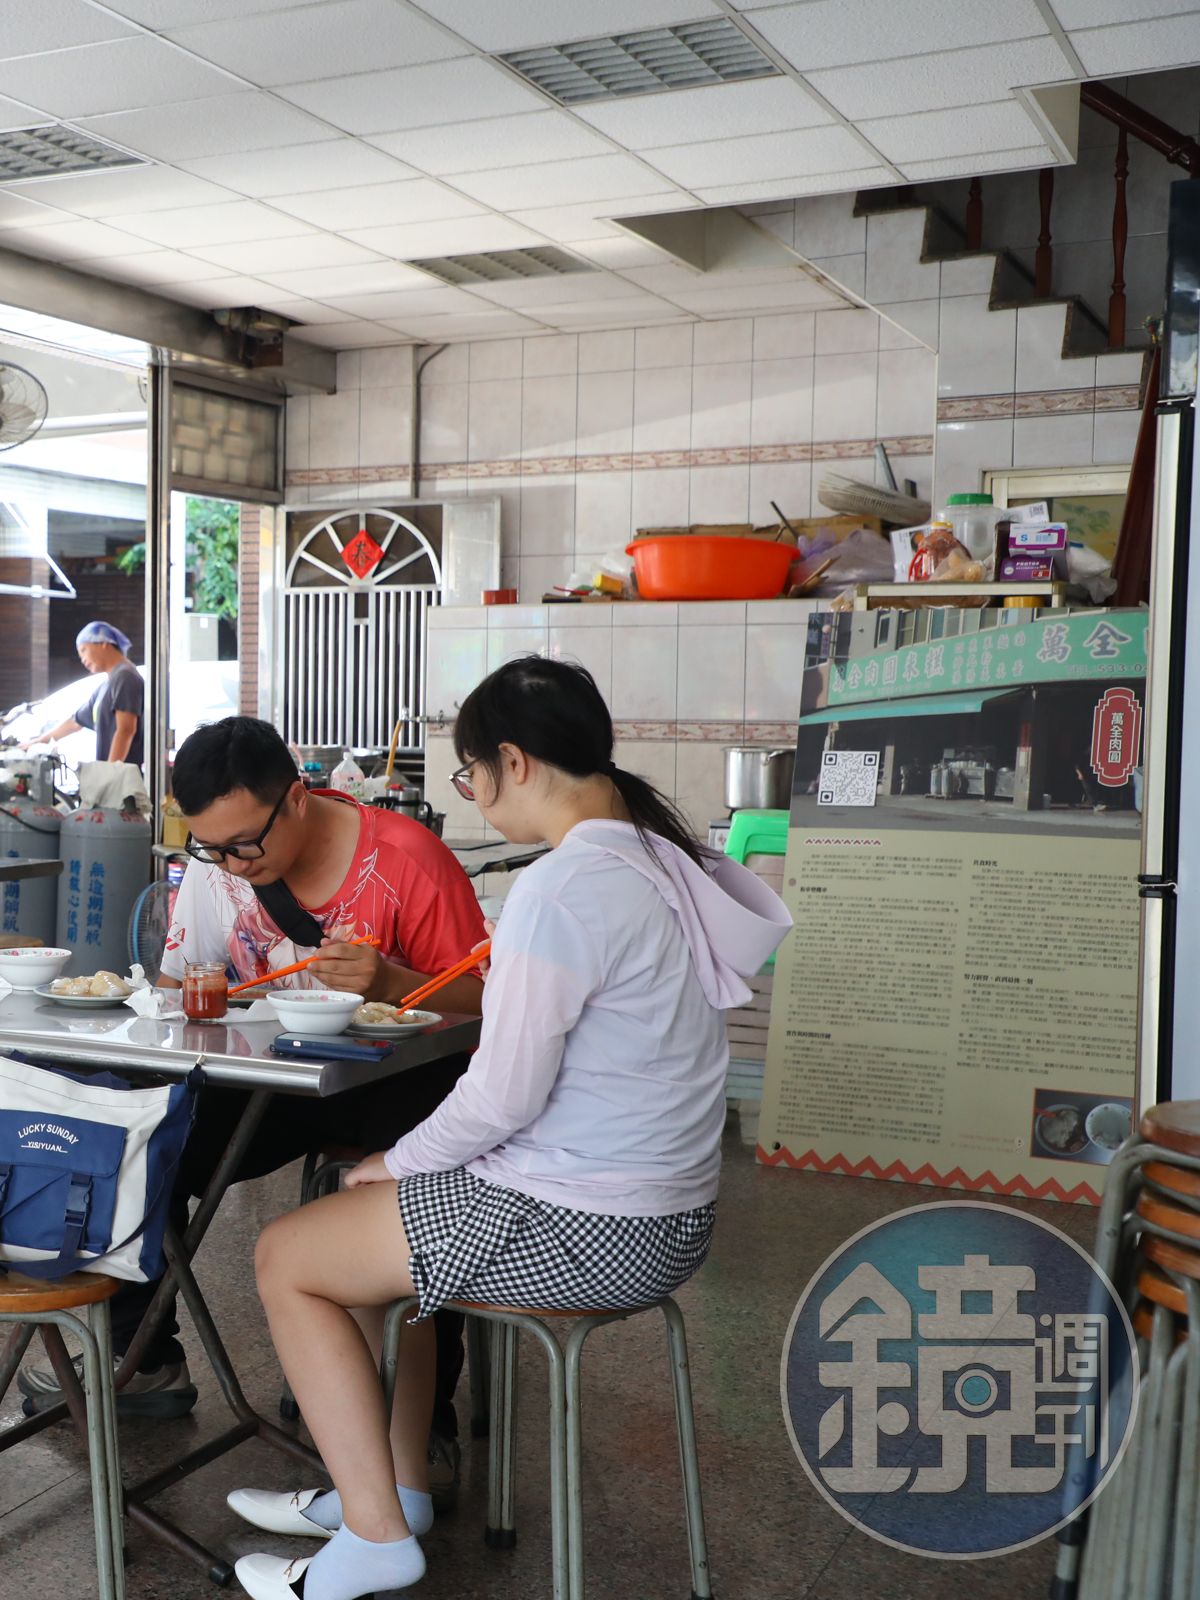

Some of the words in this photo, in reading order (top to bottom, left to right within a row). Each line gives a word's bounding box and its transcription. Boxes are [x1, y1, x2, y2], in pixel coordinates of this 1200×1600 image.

[1037, 621, 1147, 663] 萬全
[1108, 712, 1125, 764] 萬全肉圓
[18, 1123, 46, 1139] LUCKY
[46, 1124, 80, 1145] SUNDAY
